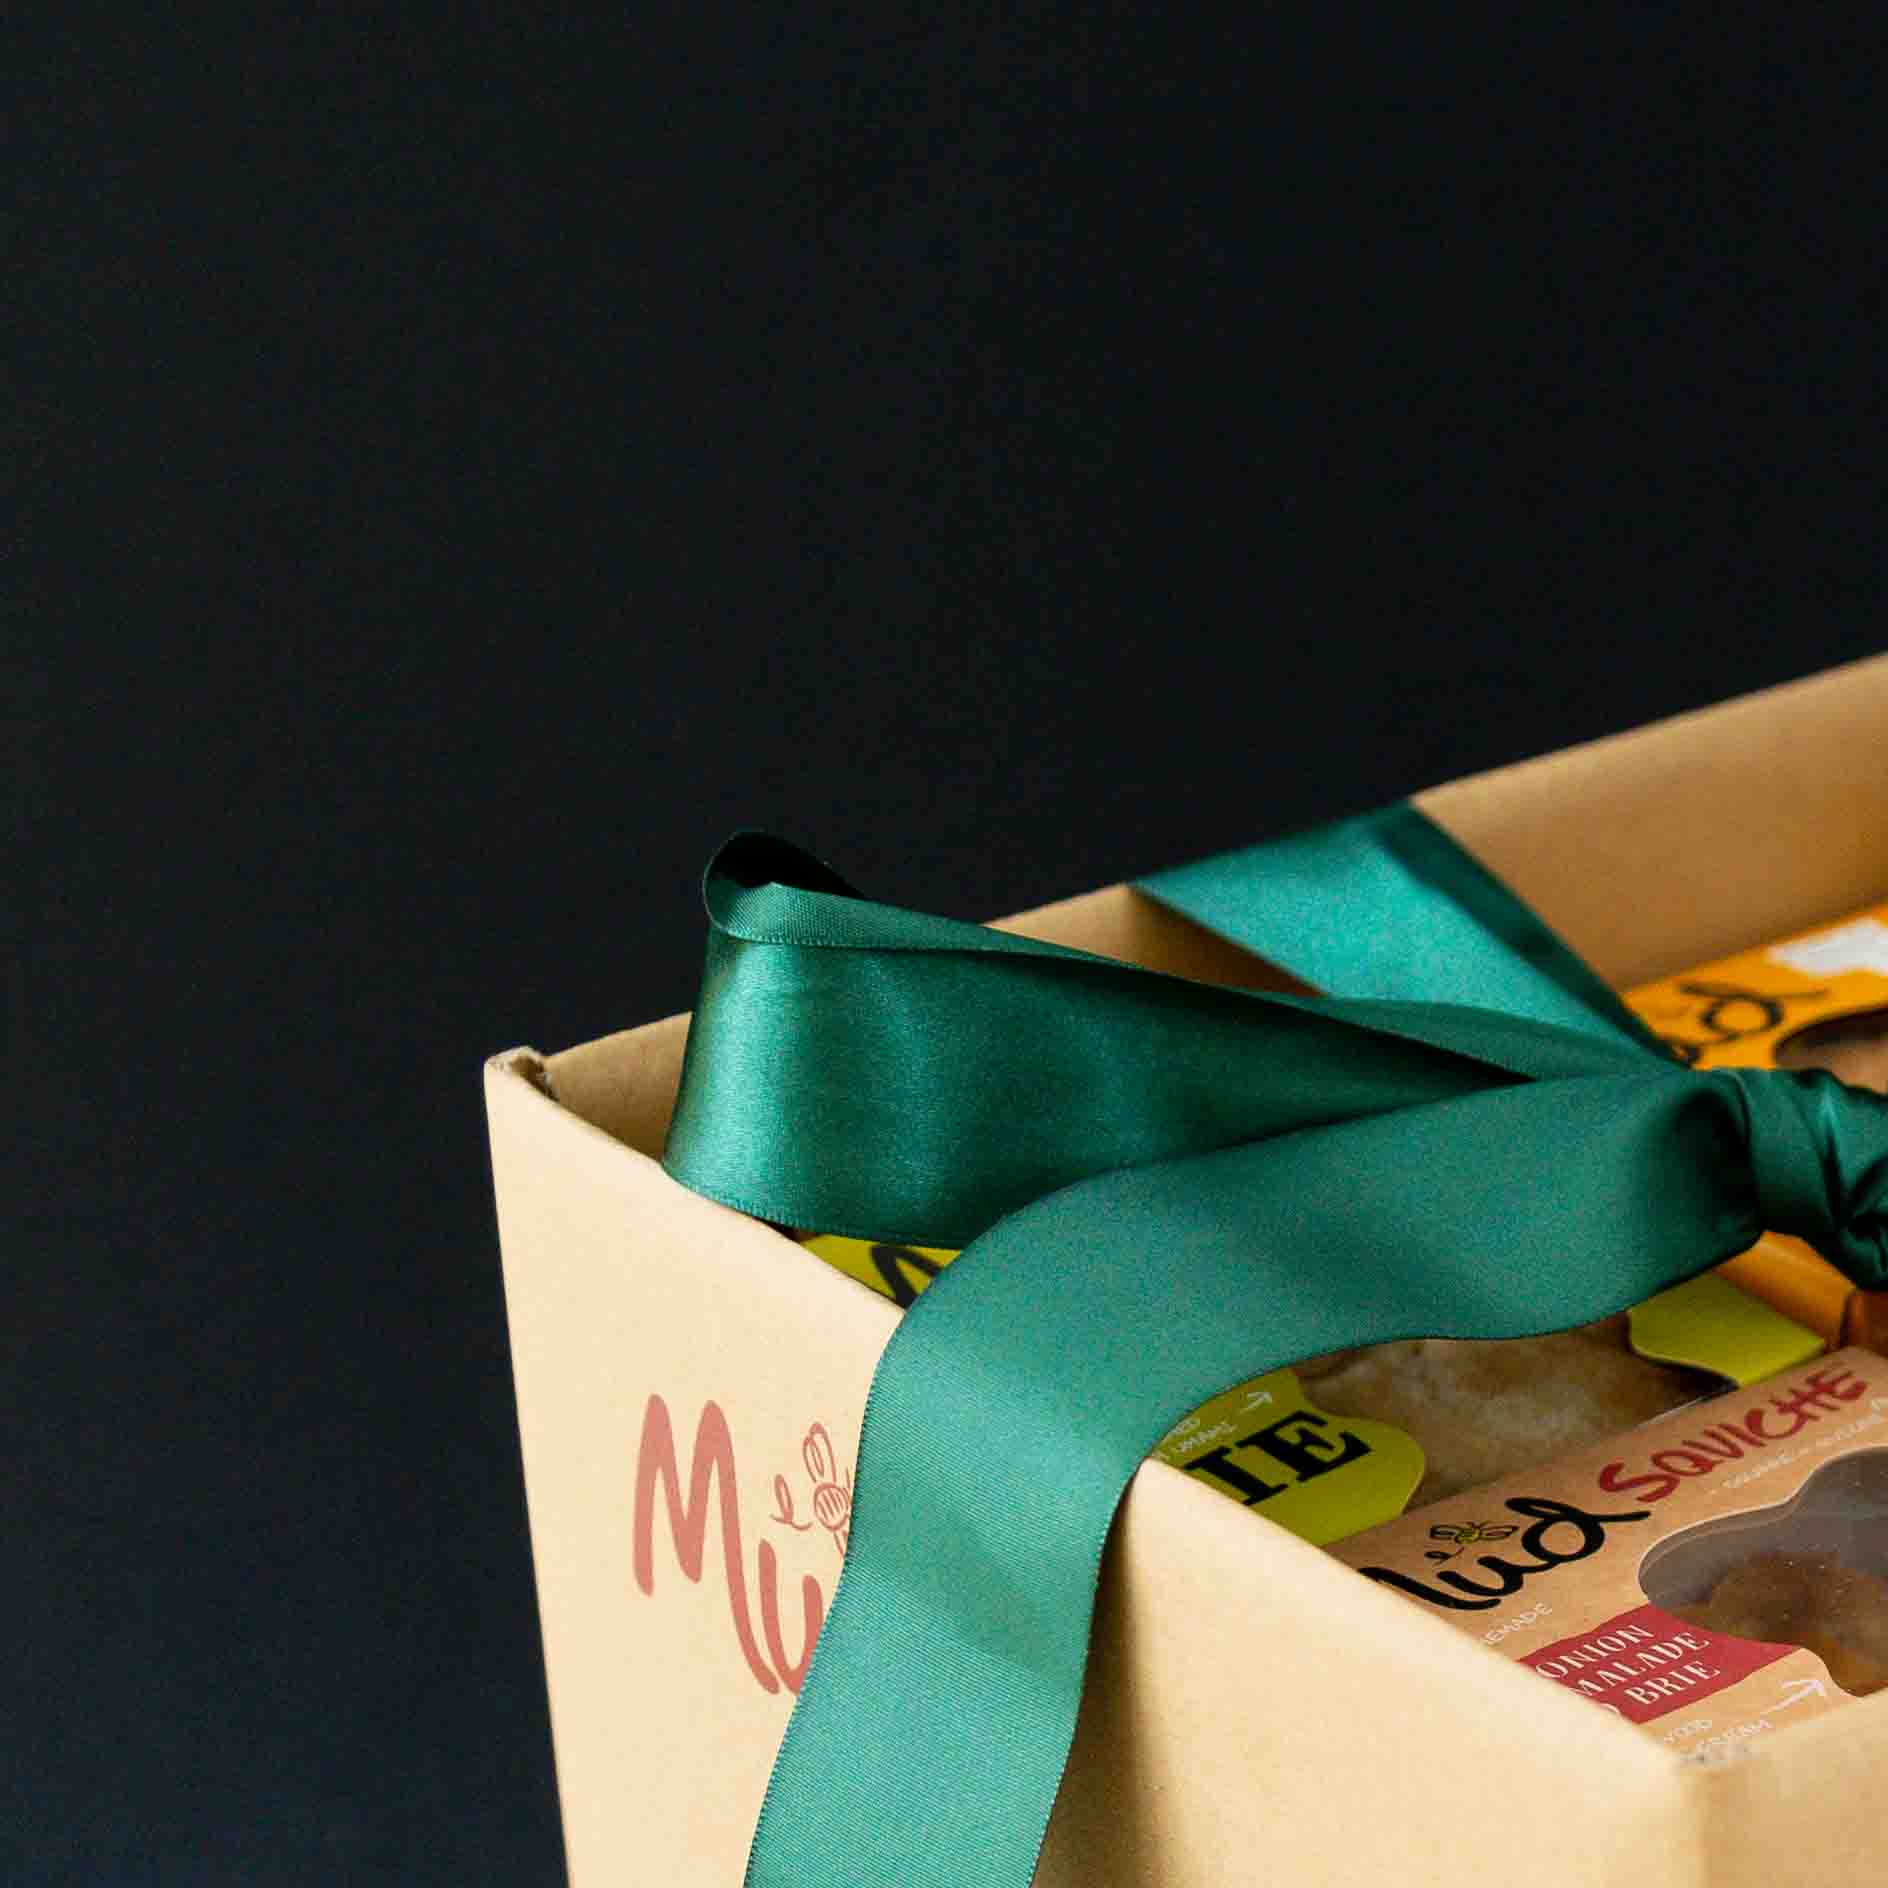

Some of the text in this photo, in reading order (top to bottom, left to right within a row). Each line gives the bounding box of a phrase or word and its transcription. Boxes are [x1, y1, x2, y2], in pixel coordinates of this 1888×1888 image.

[1184, 1410, 1373, 1505] IE
[632, 1393, 824, 1696] Mu
[1535, 1624, 1655, 1679] ONION
[1569, 1632, 1711, 1697] MALADE
[1623, 1660, 1721, 1705] BRIE
